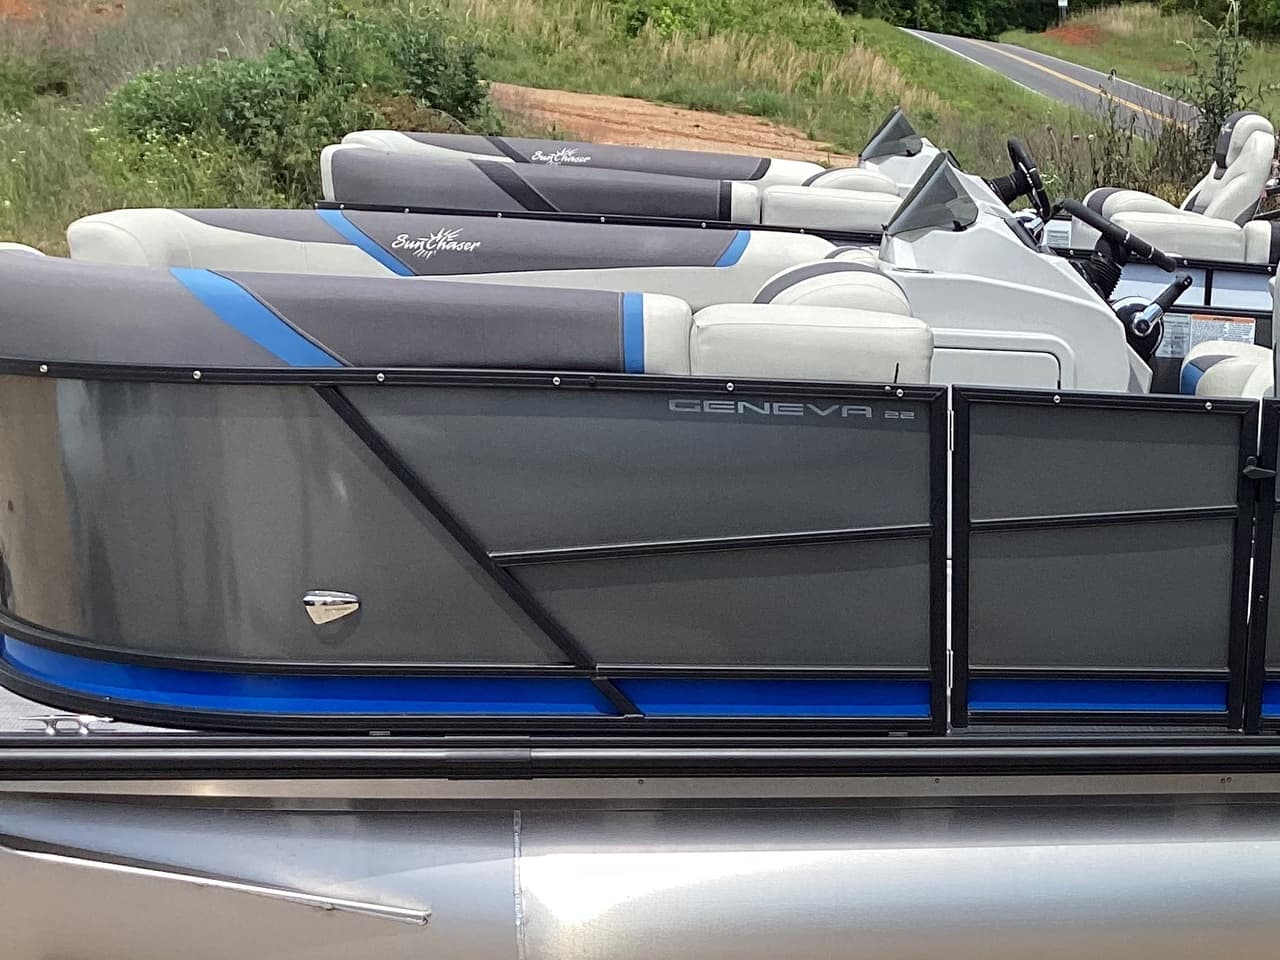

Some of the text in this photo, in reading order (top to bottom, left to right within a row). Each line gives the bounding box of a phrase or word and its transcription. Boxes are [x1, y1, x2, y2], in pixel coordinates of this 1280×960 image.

[391, 233, 481, 252] SunChaser
[668, 399, 915, 419] GENEVA 22
